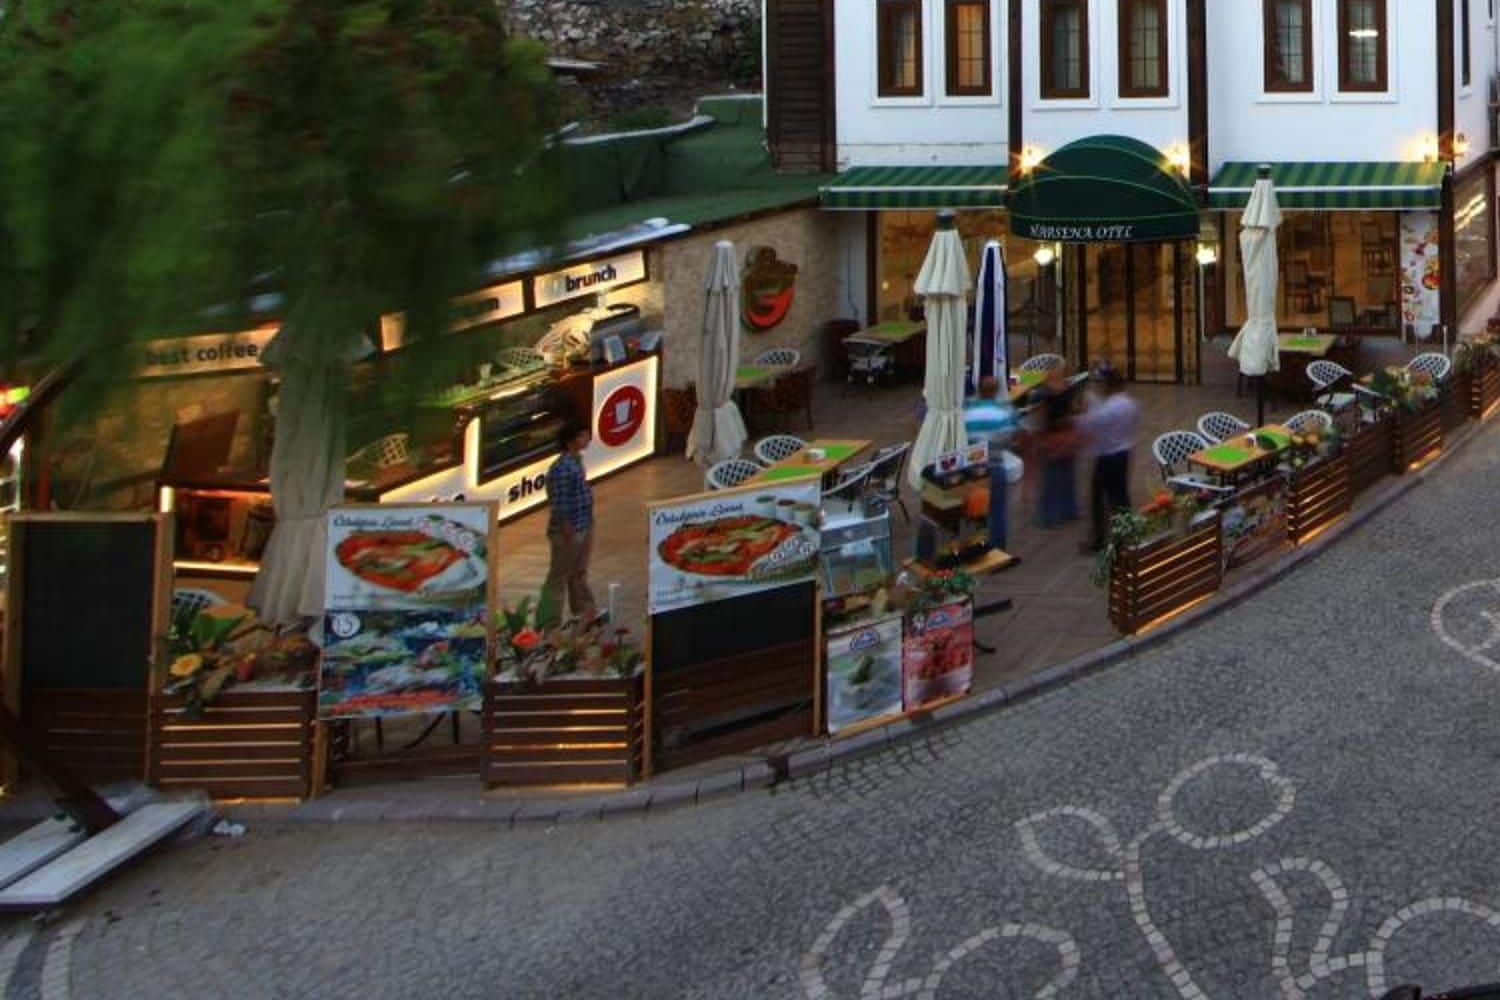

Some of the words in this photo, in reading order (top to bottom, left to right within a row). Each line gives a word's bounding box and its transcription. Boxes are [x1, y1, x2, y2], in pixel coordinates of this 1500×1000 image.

[565, 264, 617, 292] brunch
[197, 343, 258, 362] coffee
[507, 474, 546, 504] sho
